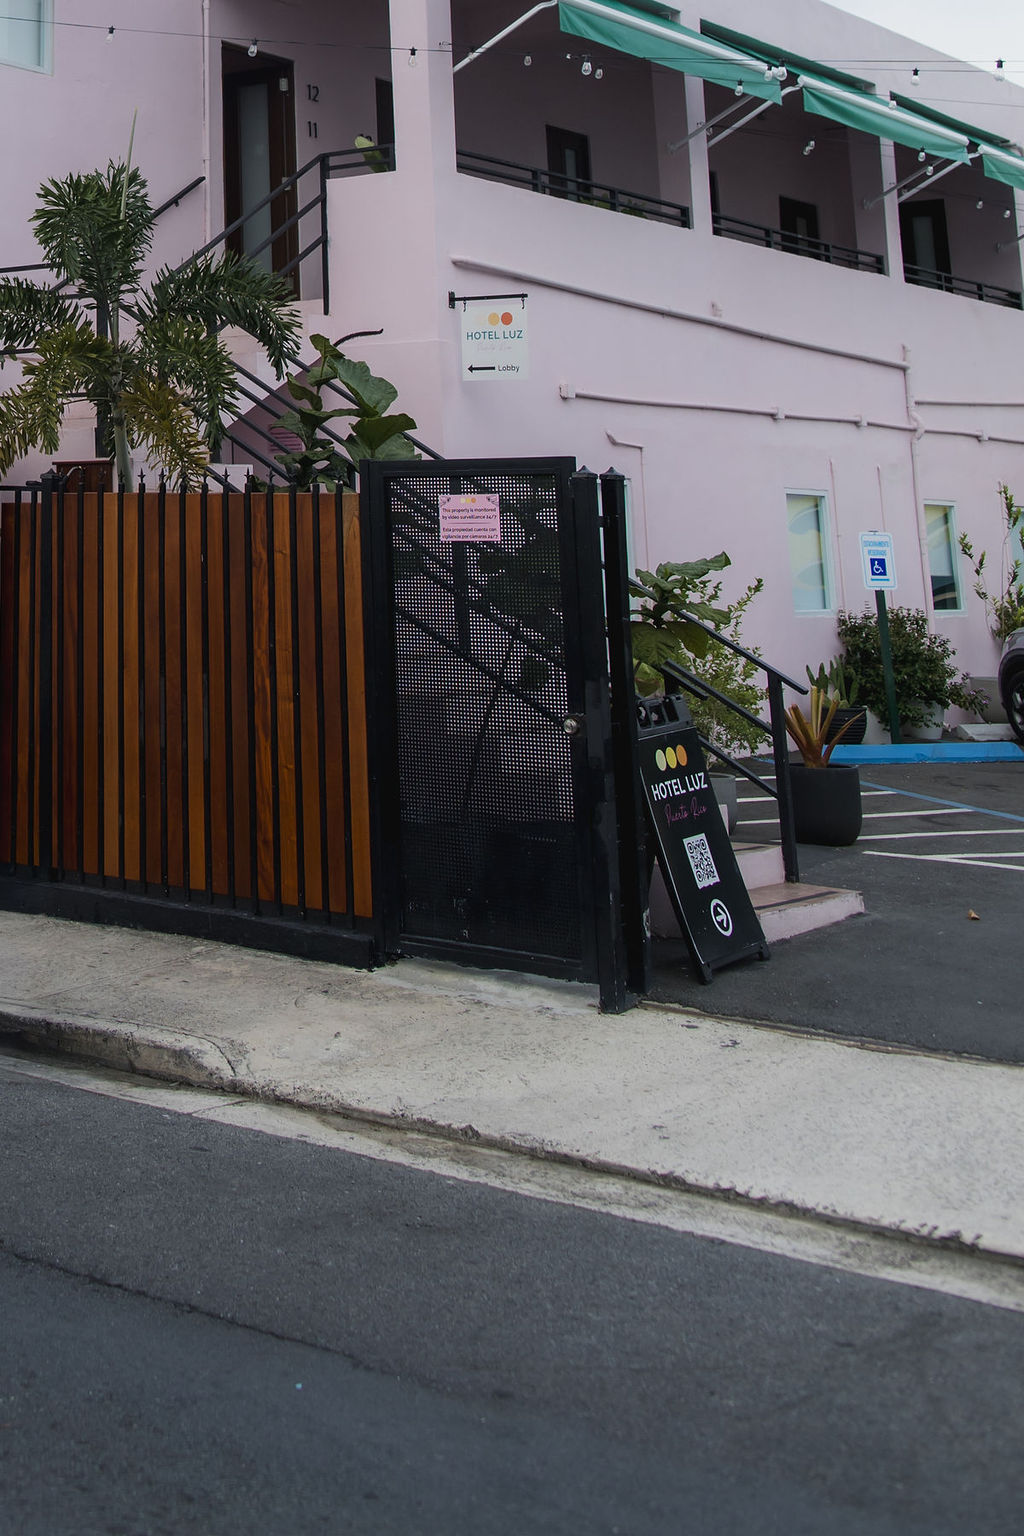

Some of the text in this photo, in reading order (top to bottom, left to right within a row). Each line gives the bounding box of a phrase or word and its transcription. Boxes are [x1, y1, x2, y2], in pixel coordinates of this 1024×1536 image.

[307, 84, 320, 102] 12
[307, 120, 318, 138] 11
[466, 330, 523, 340] HOTEL LUZ
[651, 772, 708, 801] HOTEL LUZ
